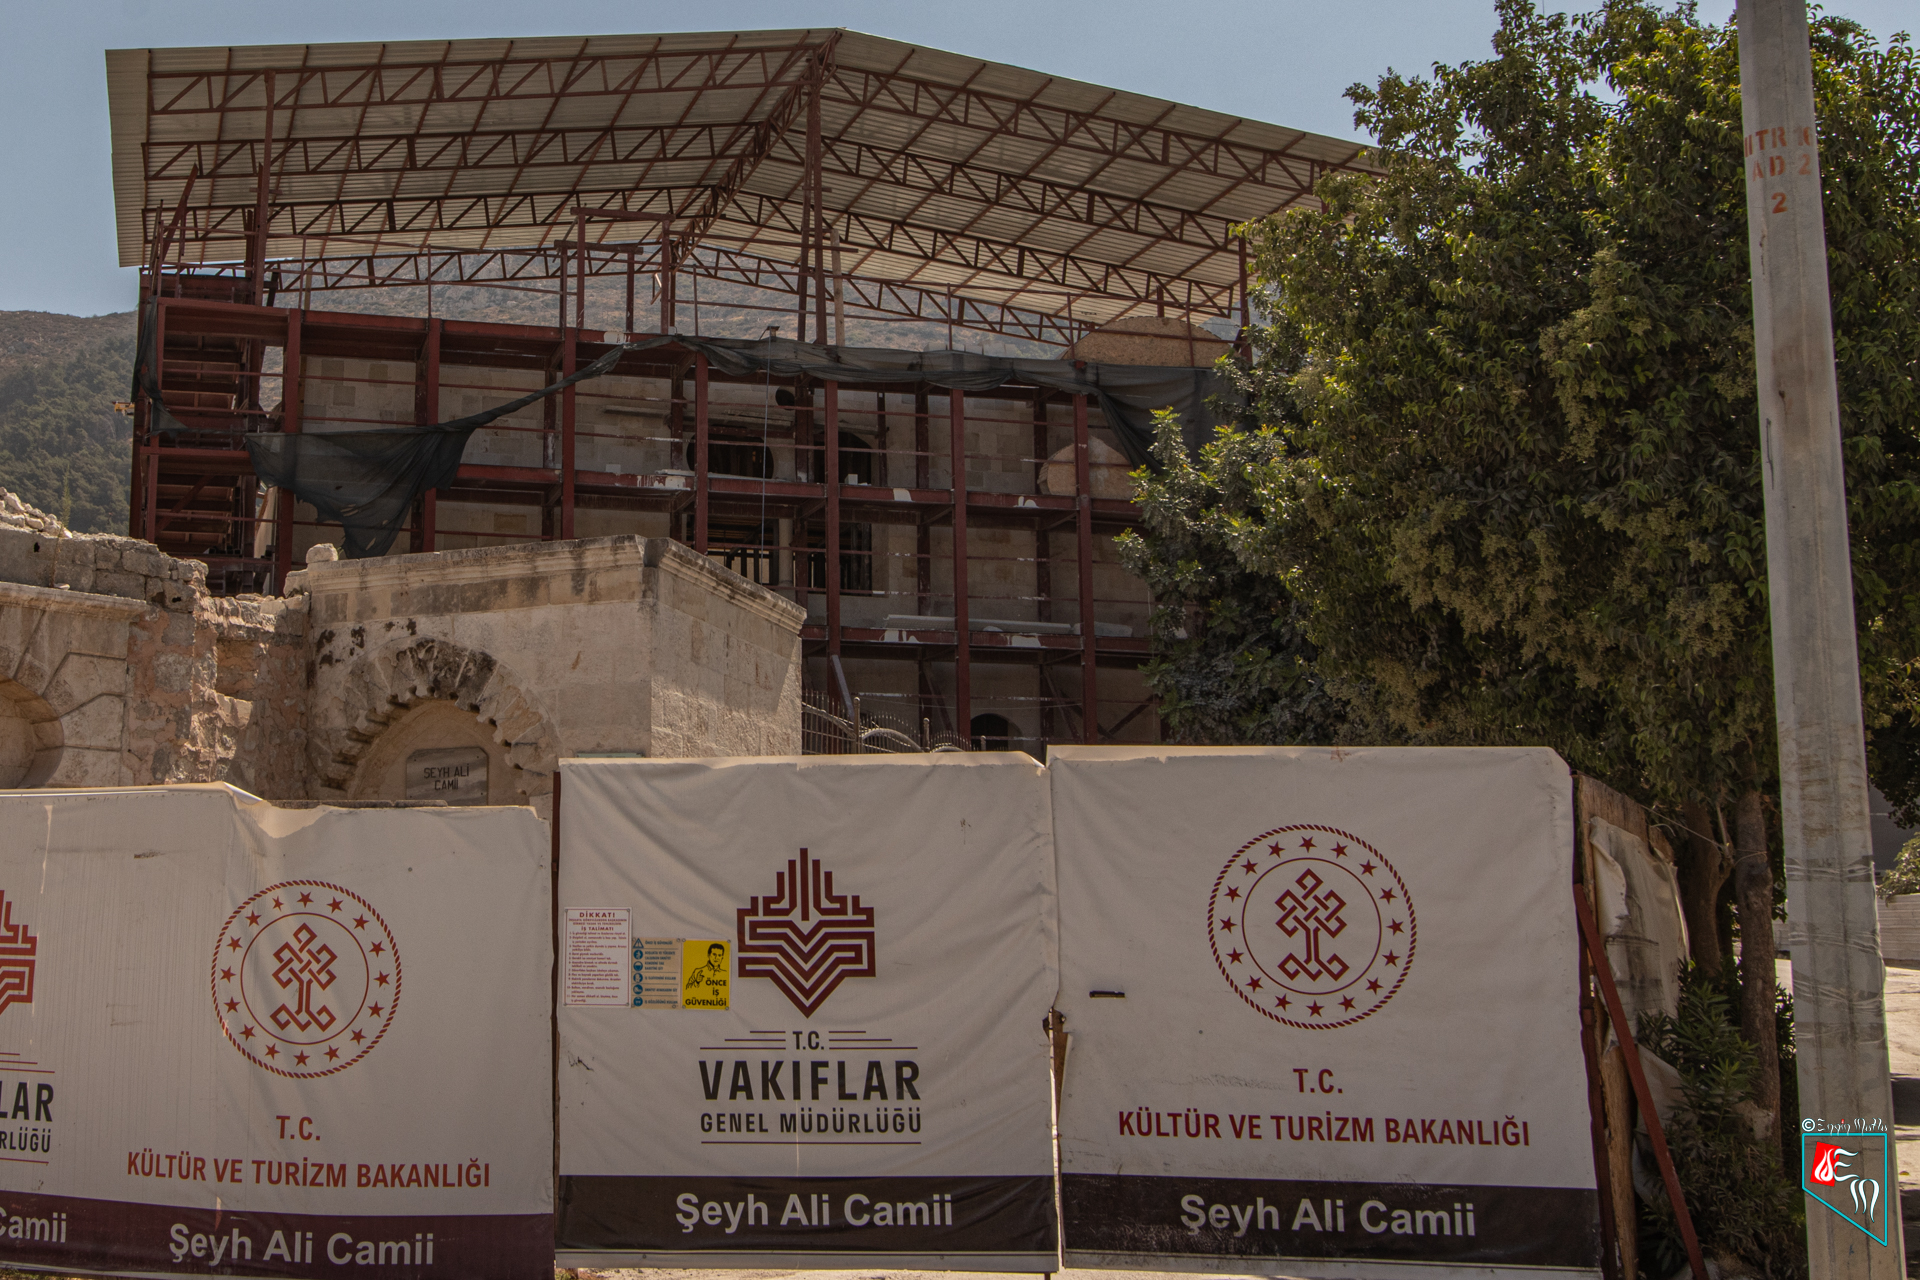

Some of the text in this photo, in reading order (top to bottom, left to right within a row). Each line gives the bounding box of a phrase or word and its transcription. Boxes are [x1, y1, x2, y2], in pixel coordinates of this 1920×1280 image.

[1771, 192, 1788, 214] 2
[705, 977, 727, 987] ÖNCE
[712, 987, 720, 997] İŞ
[685, 996, 727, 1006] GÜVENLİĞİ
[792, 1030, 824, 1050] T.C.
[698, 1060, 921, 1101] VAKIFLAR
[1292, 1068, 1344, 1094] T.C.
[275, 1115, 321, 1141] T.C.
[700, 1107, 922, 1133] GENEL MÜDÜRLÜĞÜ
[1118, 1106, 1530, 1147] KÜLTÜR VE TURİZM BAKANLIĞI
[127, 1148, 490, 1188] KÜLTÜR VE TURİZM BAKANLIĞI
[676, 1192, 953, 1234] Şeyh Ali Camii
[1180, 1194, 1476, 1237] Şeyh Ali Camii
[169, 1223, 434, 1266] Şeyh Ali Camii
